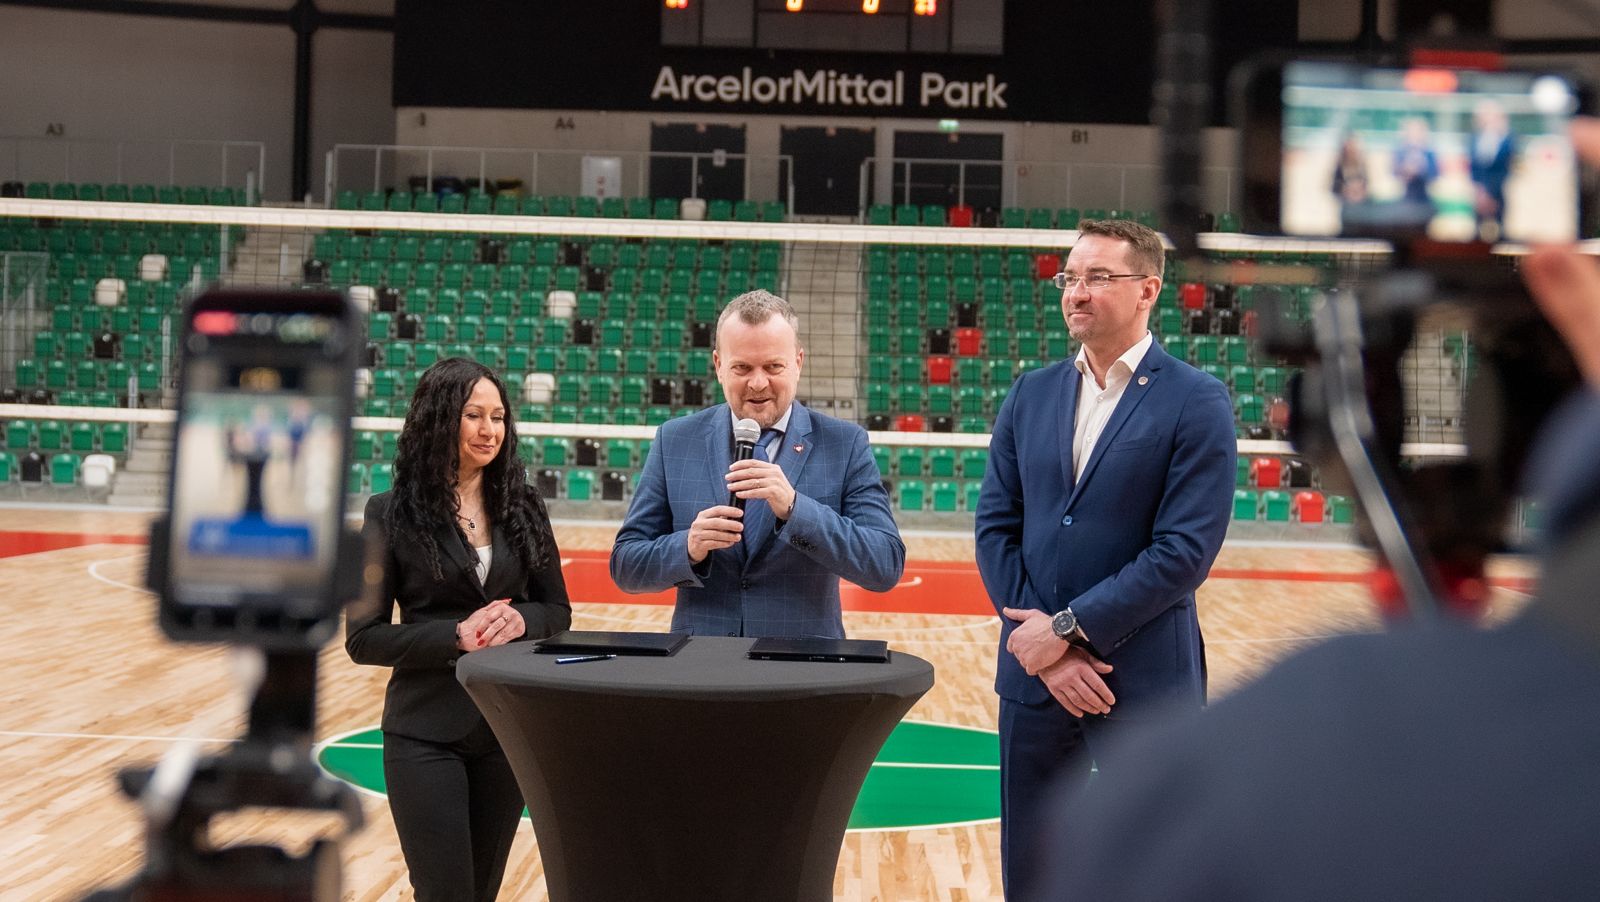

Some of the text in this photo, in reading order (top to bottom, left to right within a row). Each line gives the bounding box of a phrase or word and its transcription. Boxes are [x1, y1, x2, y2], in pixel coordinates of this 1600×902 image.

[651, 65, 1008, 109] ArcelorMittal Park
[45, 122, 64, 137] A3
[555, 116, 576, 130] A4
[1071, 129, 1088, 144] B1
